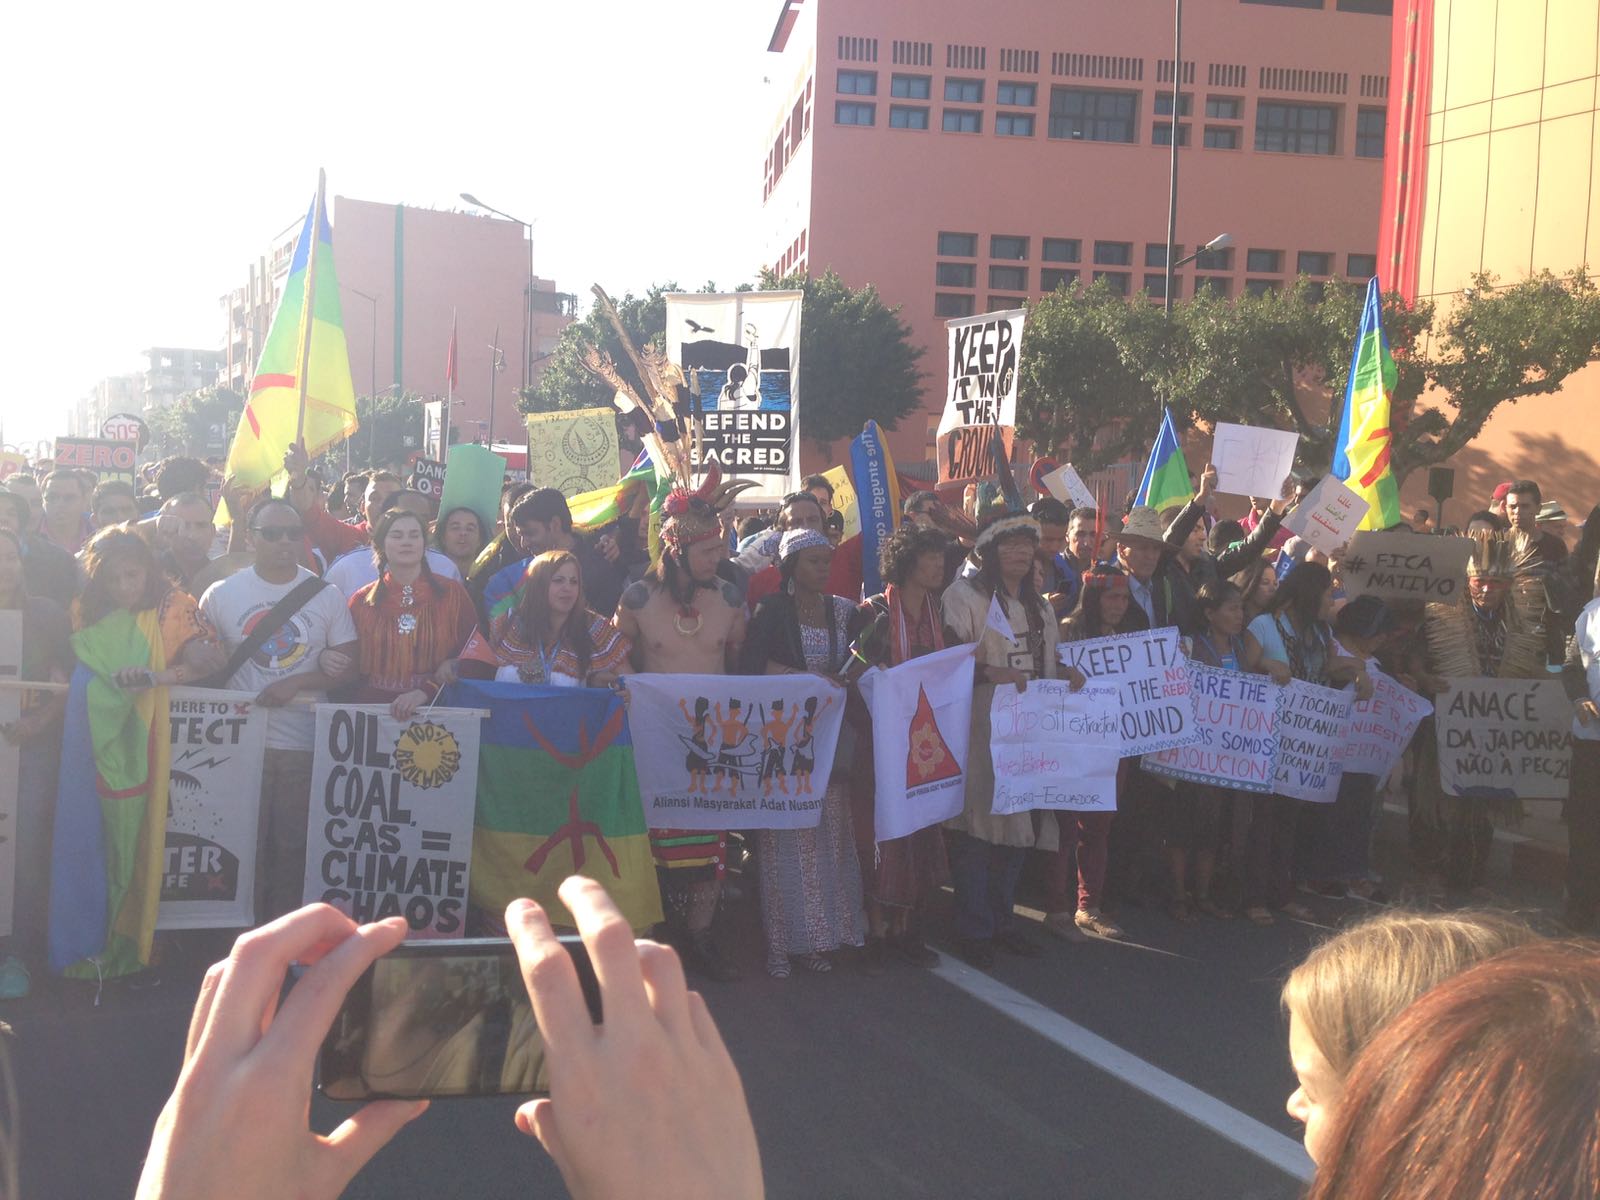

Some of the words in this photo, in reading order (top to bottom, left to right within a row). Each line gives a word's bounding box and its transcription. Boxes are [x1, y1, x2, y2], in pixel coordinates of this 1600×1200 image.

[953, 320, 1012, 379] KEEP
[953, 376, 971, 402] IT
[977, 374, 995, 399] IN
[956, 400, 993, 425] THE
[722, 433, 751, 444] THE
[56, 443, 135, 469] ZERO
[691, 447, 785, 465] SACRED
[1376, 552, 1433, 574] FICA
[1366, 572, 1456, 596] NATIVO
[1070, 644, 1132, 678] KEEP
[1143, 637, 1168, 667] IT
[1128, 678, 1162, 704] THE
[1239, 680, 1268, 703] THE
[1448, 682, 1541, 722] ANACÉ
[170, 700, 206, 715] HERE
[209, 701, 229, 715] TO
[169, 717, 248, 745] TECT
[1120, 706, 1184, 740] OUND
[1293, 713, 1329, 735] TOCAN
[328, 709, 395, 770] OIL,
[1221, 730, 1274, 757] SOMOS
[1279, 735, 1316, 756] TOCAN
[1317, 745, 1329, 759] LA
[1446, 727, 1477, 749] DA
[396, 748, 460, 790] RENEWABLES
[1182, 748, 1268, 780] SOLUCION
[1280, 752, 1311, 771] TOCAN
[1313, 761, 1325, 774] LA
[1456, 751, 1493, 775] NÃO
[1274, 766, 1289, 783] LA
[1299, 770, 1327, 790] VIDA
[325, 765, 417, 828] COAL,
[653, 797, 691, 809] Aliansi
[694, 797, 757, 812] Masyarakat
[760, 798, 787, 811] Adat
[324, 817, 402, 854] GAS
[165, 845, 223, 874] TER
[166, 874, 188, 888] FE
[321, 850, 467, 898] CLIMATE
